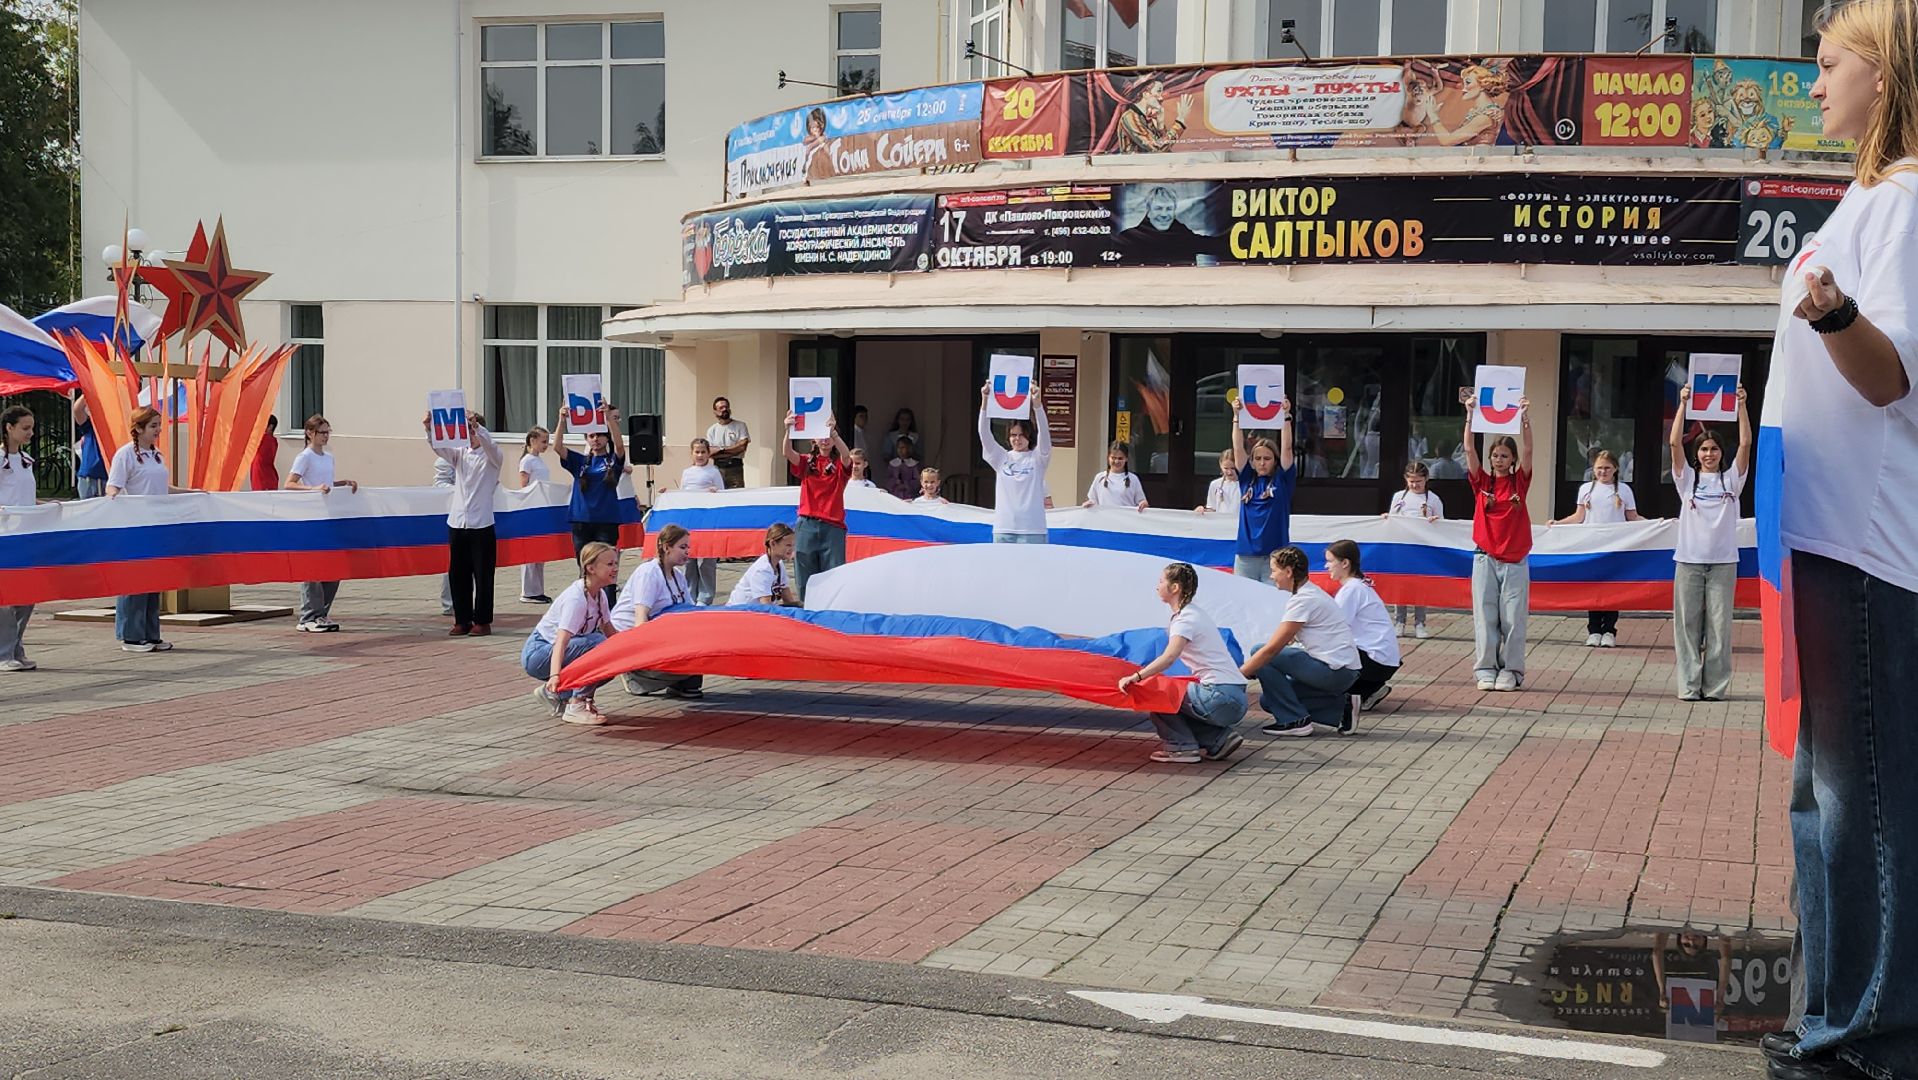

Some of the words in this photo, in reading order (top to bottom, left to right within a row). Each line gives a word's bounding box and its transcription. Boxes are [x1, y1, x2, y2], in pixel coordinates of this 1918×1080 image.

[1224, 84, 1289, 98] УХТЫ
[1313, 81, 1401, 95] ПУХТЫ
[1593, 72, 1686, 97] НАЧАЛО
[1768, 70, 1799, 97] 18
[916, 100, 947, 117] 12:00
[1003, 86, 1035, 121] 20
[1594, 102, 1682, 138] 12:00
[953, 138, 971, 153] 6+
[1231, 186, 1337, 218] ВИКТОР
[939, 210, 967, 243] 17
[1513, 203, 1662, 230] ИСТОРИЯ
[1229, 218, 1425, 259] САЛТЫКОВ
[1503, 233, 1563, 244] новое
[1574, 235, 1584, 244] и
[1595, 235, 1672, 247] лучшее
[1743, 209, 1797, 259] 26
[936, 245, 1022, 268] ОКТЯБРЯ
[1042, 251, 1074, 265] 19:00
[1100, 250, 1122, 262] 12+
[1692, 360, 1738, 412] И
[432, 397, 467, 440] М
